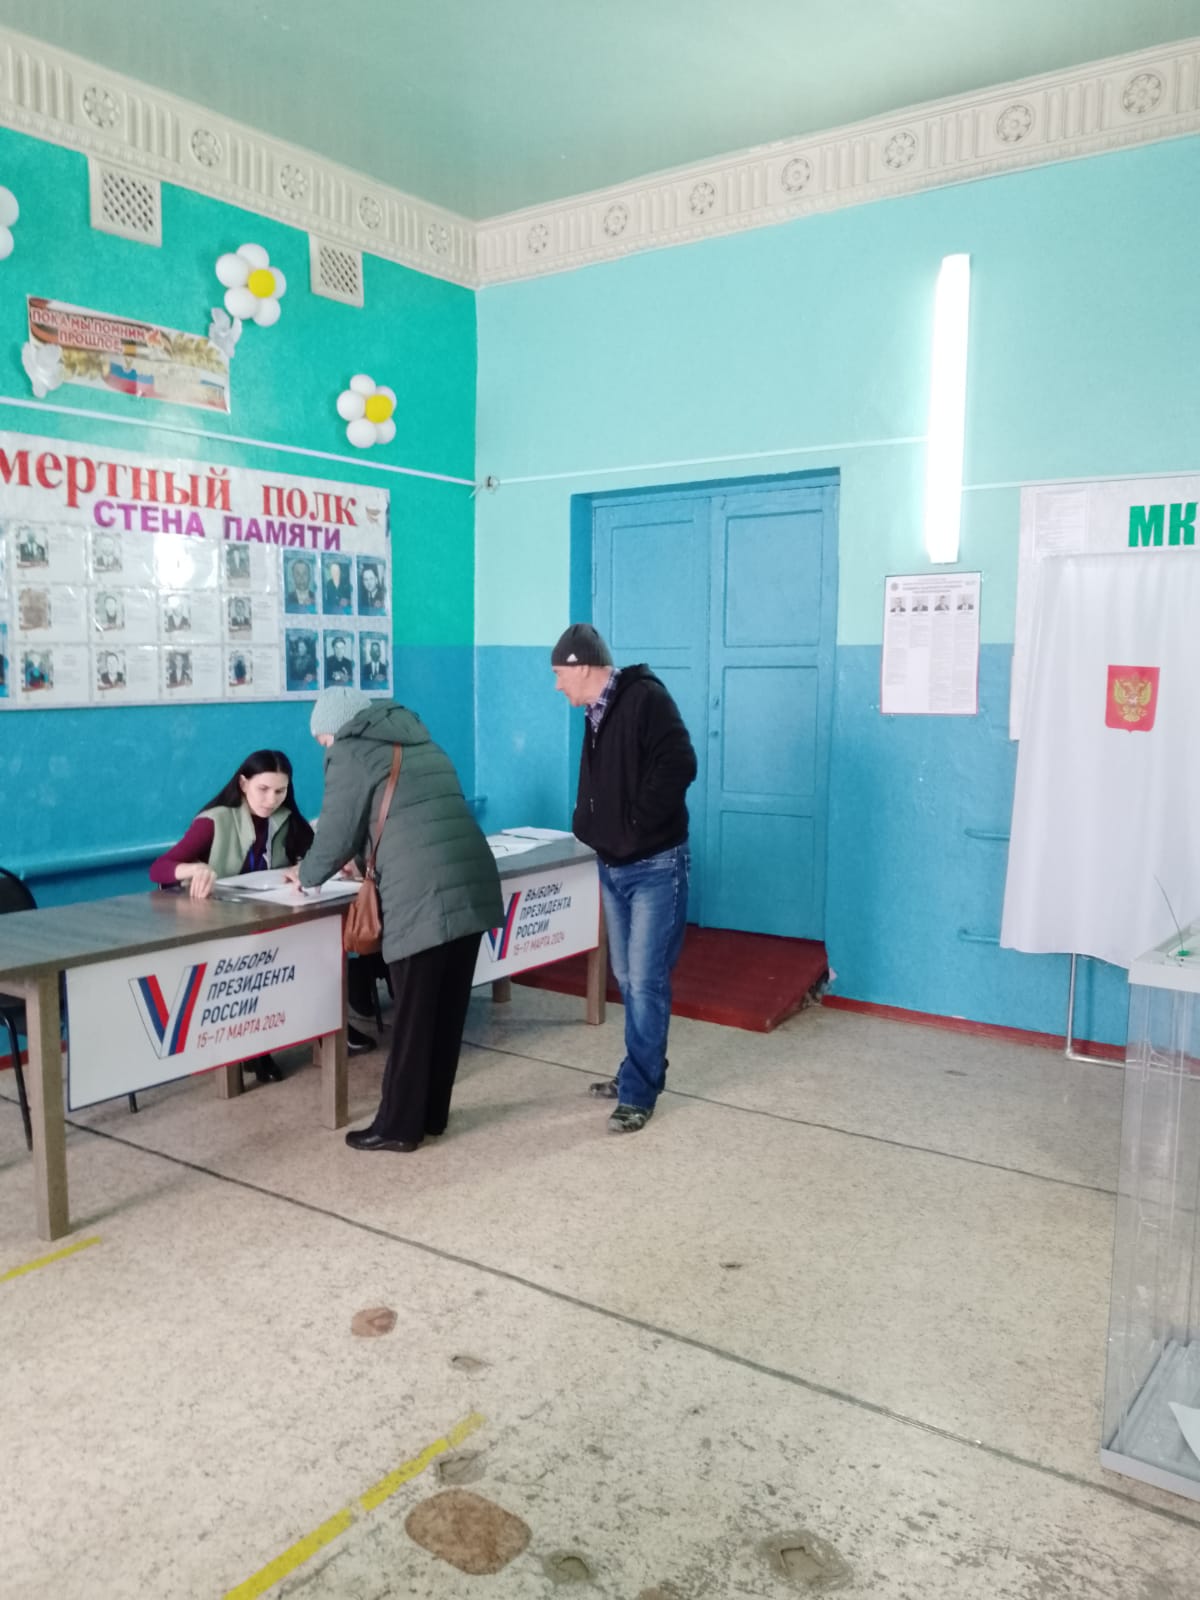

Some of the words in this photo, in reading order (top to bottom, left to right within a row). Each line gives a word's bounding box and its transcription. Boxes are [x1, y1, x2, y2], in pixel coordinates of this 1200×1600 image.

[93, 499, 206, 538] СТЕНА
[223, 515, 341, 551] ПАМЯТИ
[524, 881, 564, 903] ВЫБОРЫ
[519, 896, 572, 921] ПРЕЗИДЕНТА
[515, 918, 550, 940] РОССИИ
[214, 946, 279, 977] ВЫБОРЫ
[206, 965, 296, 1003] ПРЕЗИДЕНТА
[200, 995, 259, 1027] РОССИИ
[227, 1016, 261, 1040] МАРТА
[262, 1008, 287, 1032] 2024
